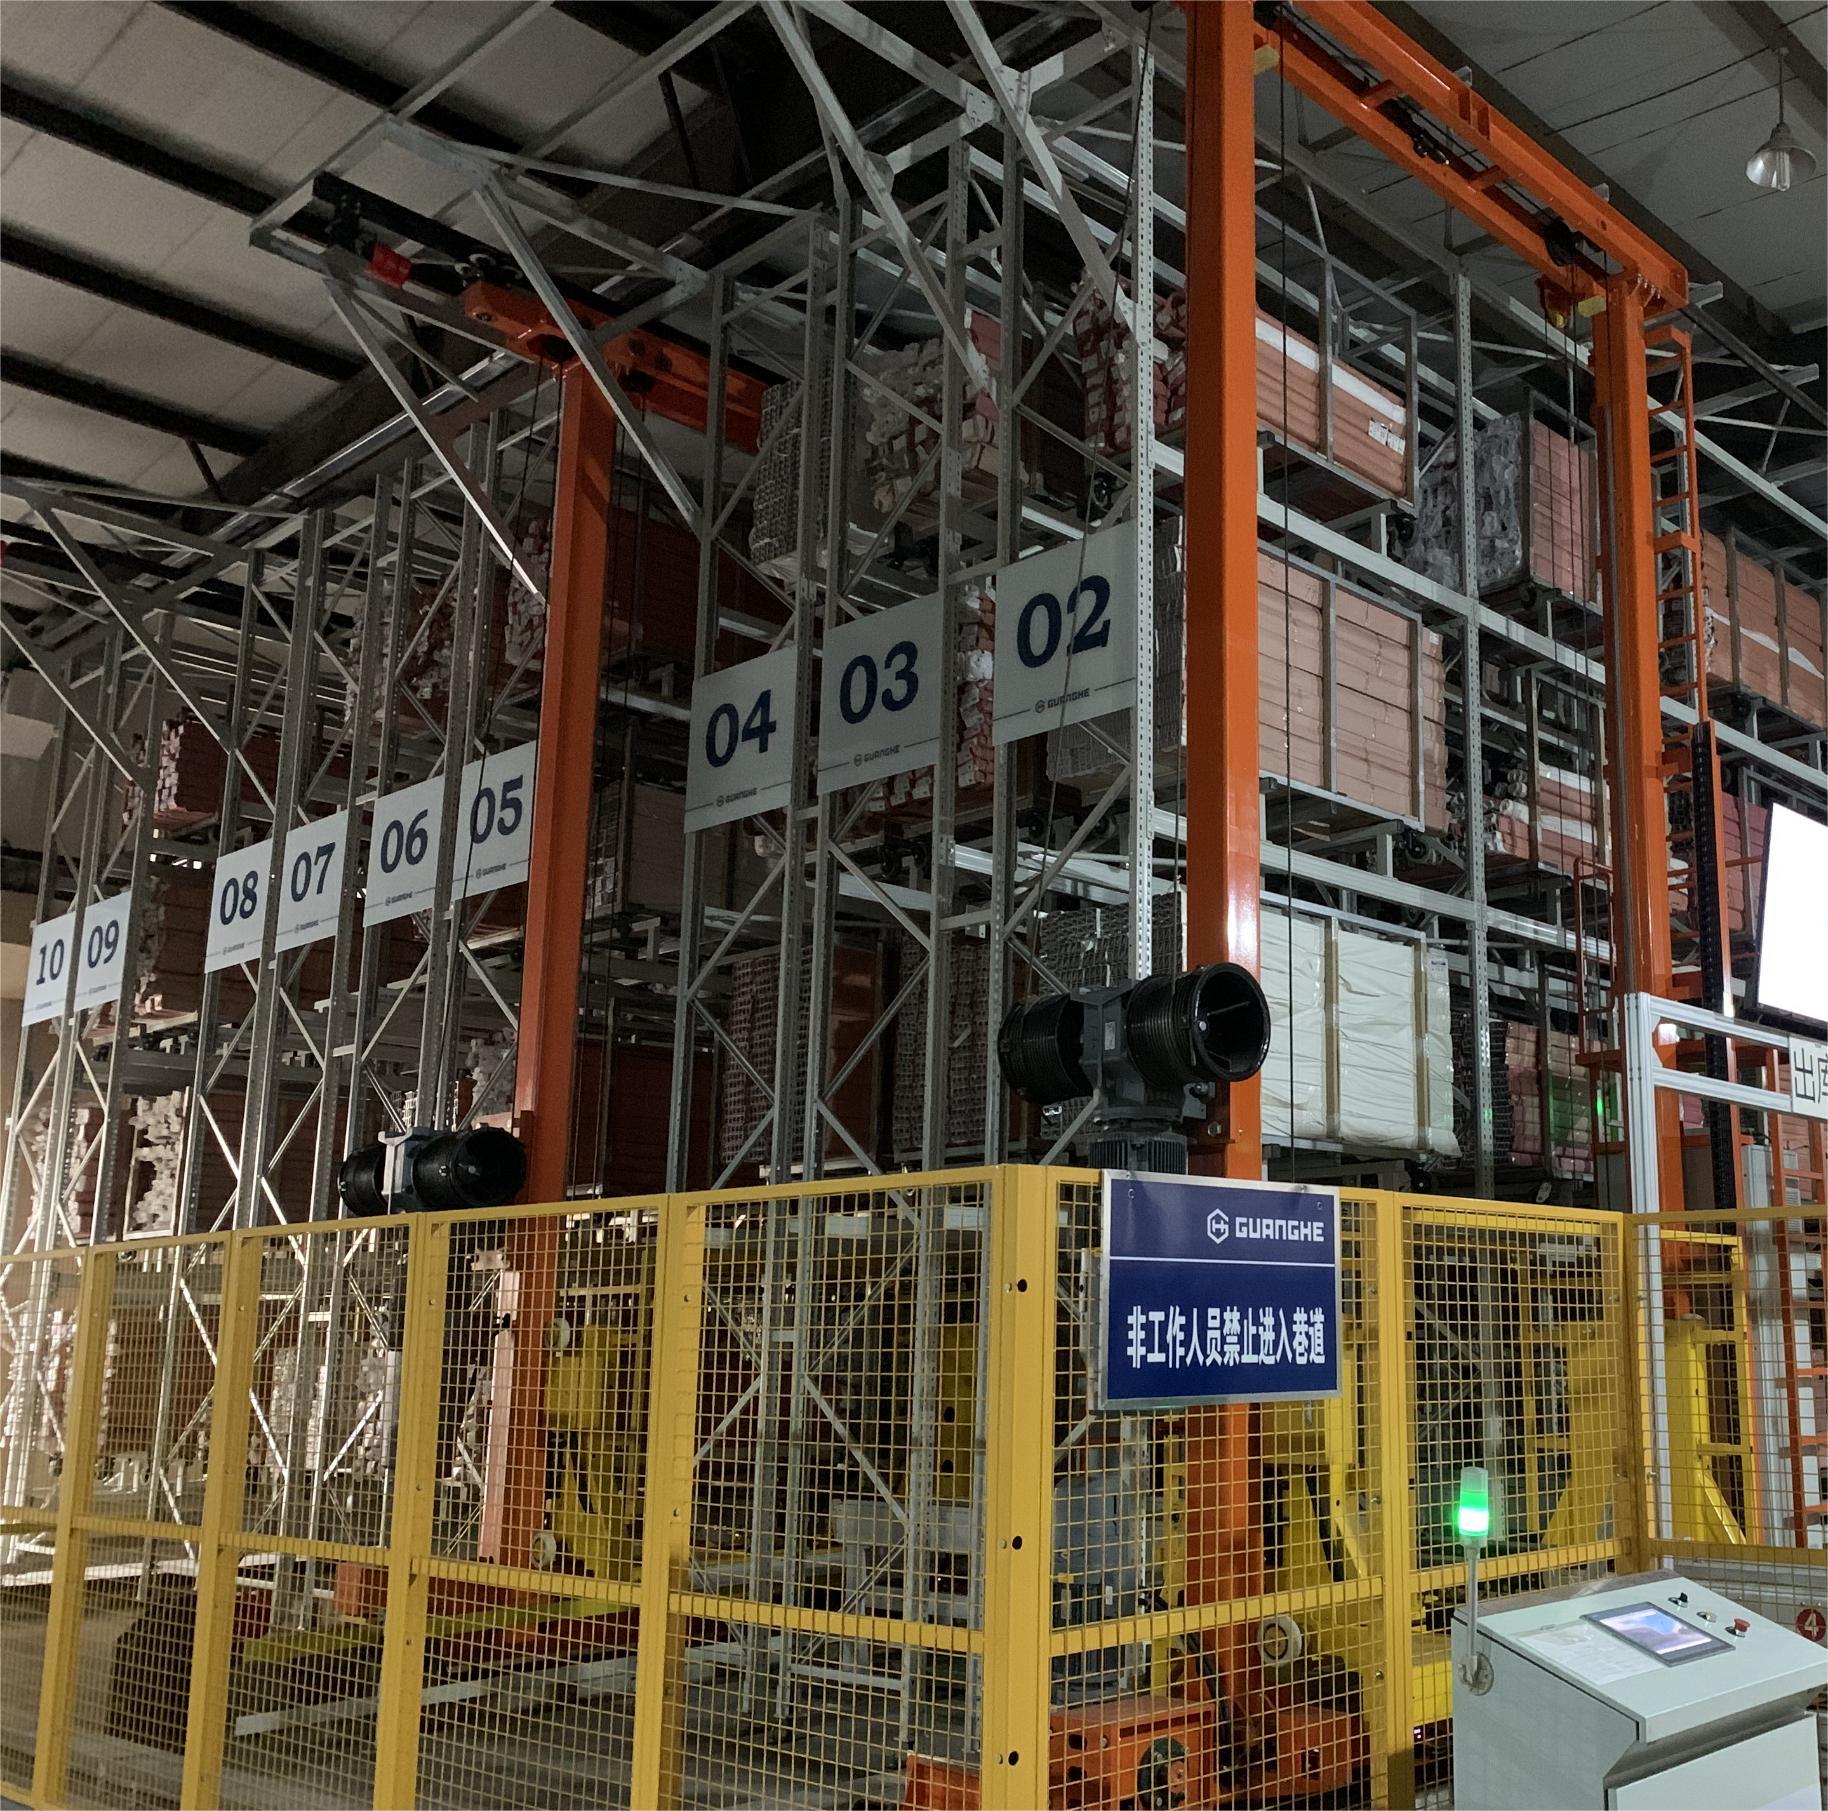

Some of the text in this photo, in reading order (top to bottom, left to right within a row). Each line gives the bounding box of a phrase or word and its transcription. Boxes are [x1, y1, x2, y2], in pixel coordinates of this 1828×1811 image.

[1017, 575, 1111, 668] 02
[840, 641, 919, 724] 03
[1048, 688, 1090, 708] GUANGHE
[706, 689, 777, 768] 04
[470, 774, 523, 844] 05
[380, 809, 428, 873] 06
[220, 870, 258, 925] 08
[291, 842, 336, 902] 07
[36, 938, 64, 985] 10
[88, 920, 119, 968] 09
[1235, 1216, 1324, 1242] GUANGHE
[1127, 1305, 1325, 1369] 非工作人员禁止进入巷道
[1804, 1612, 1819, 1638] 4
